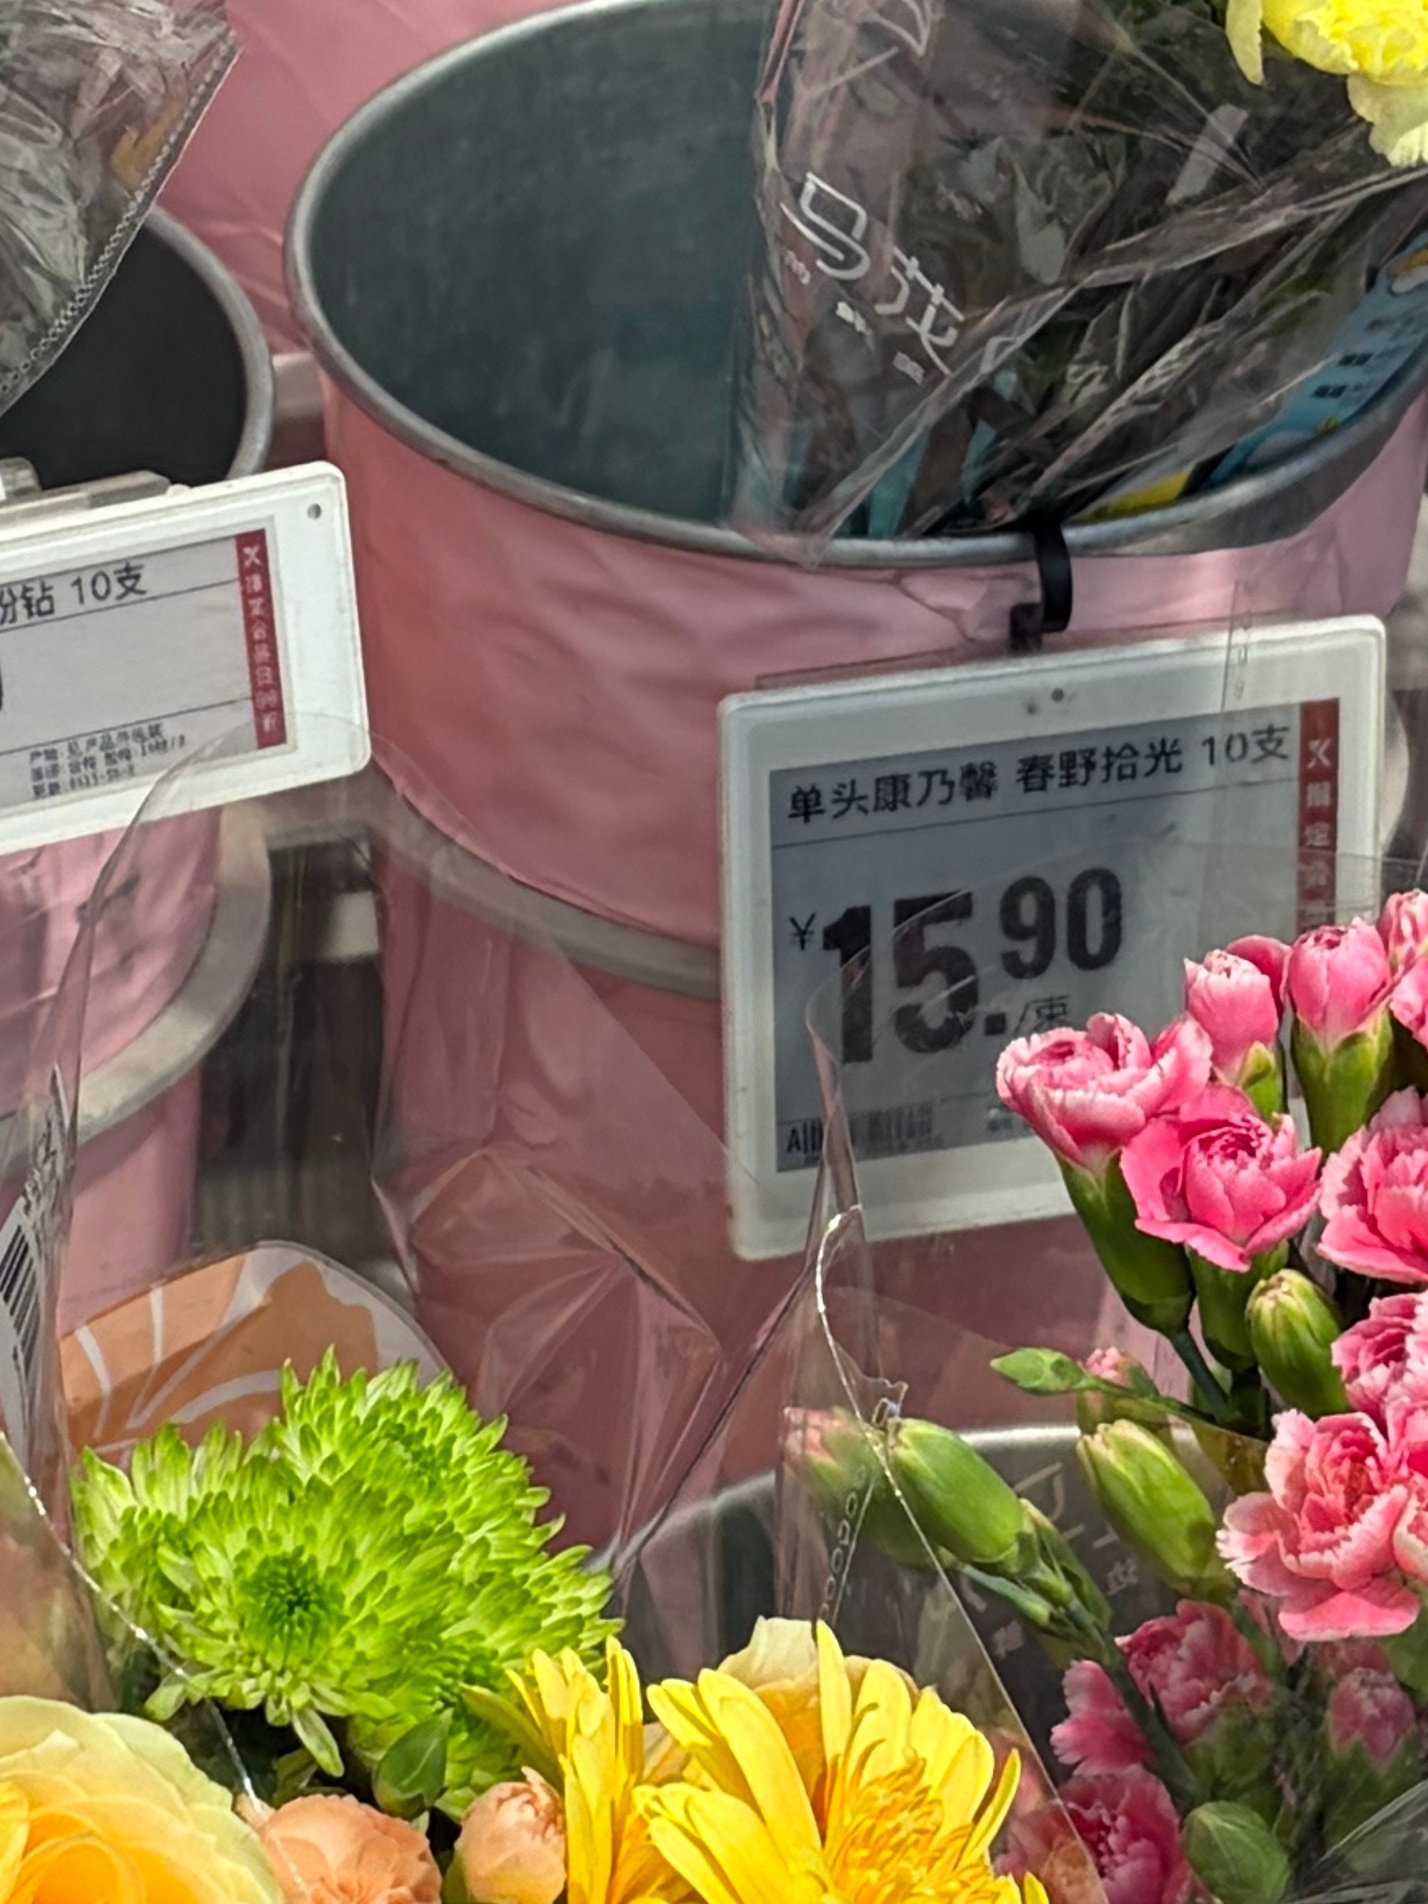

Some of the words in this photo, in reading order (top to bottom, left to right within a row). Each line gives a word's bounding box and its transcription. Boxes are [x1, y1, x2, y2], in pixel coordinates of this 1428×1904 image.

[70, 561, 147, 613] 10支
[786, 761, 998, 825] 单头康乃馨
[1014, 738, 1184, 795] 春野拾光
[1200, 722, 1290, 767] 10支
